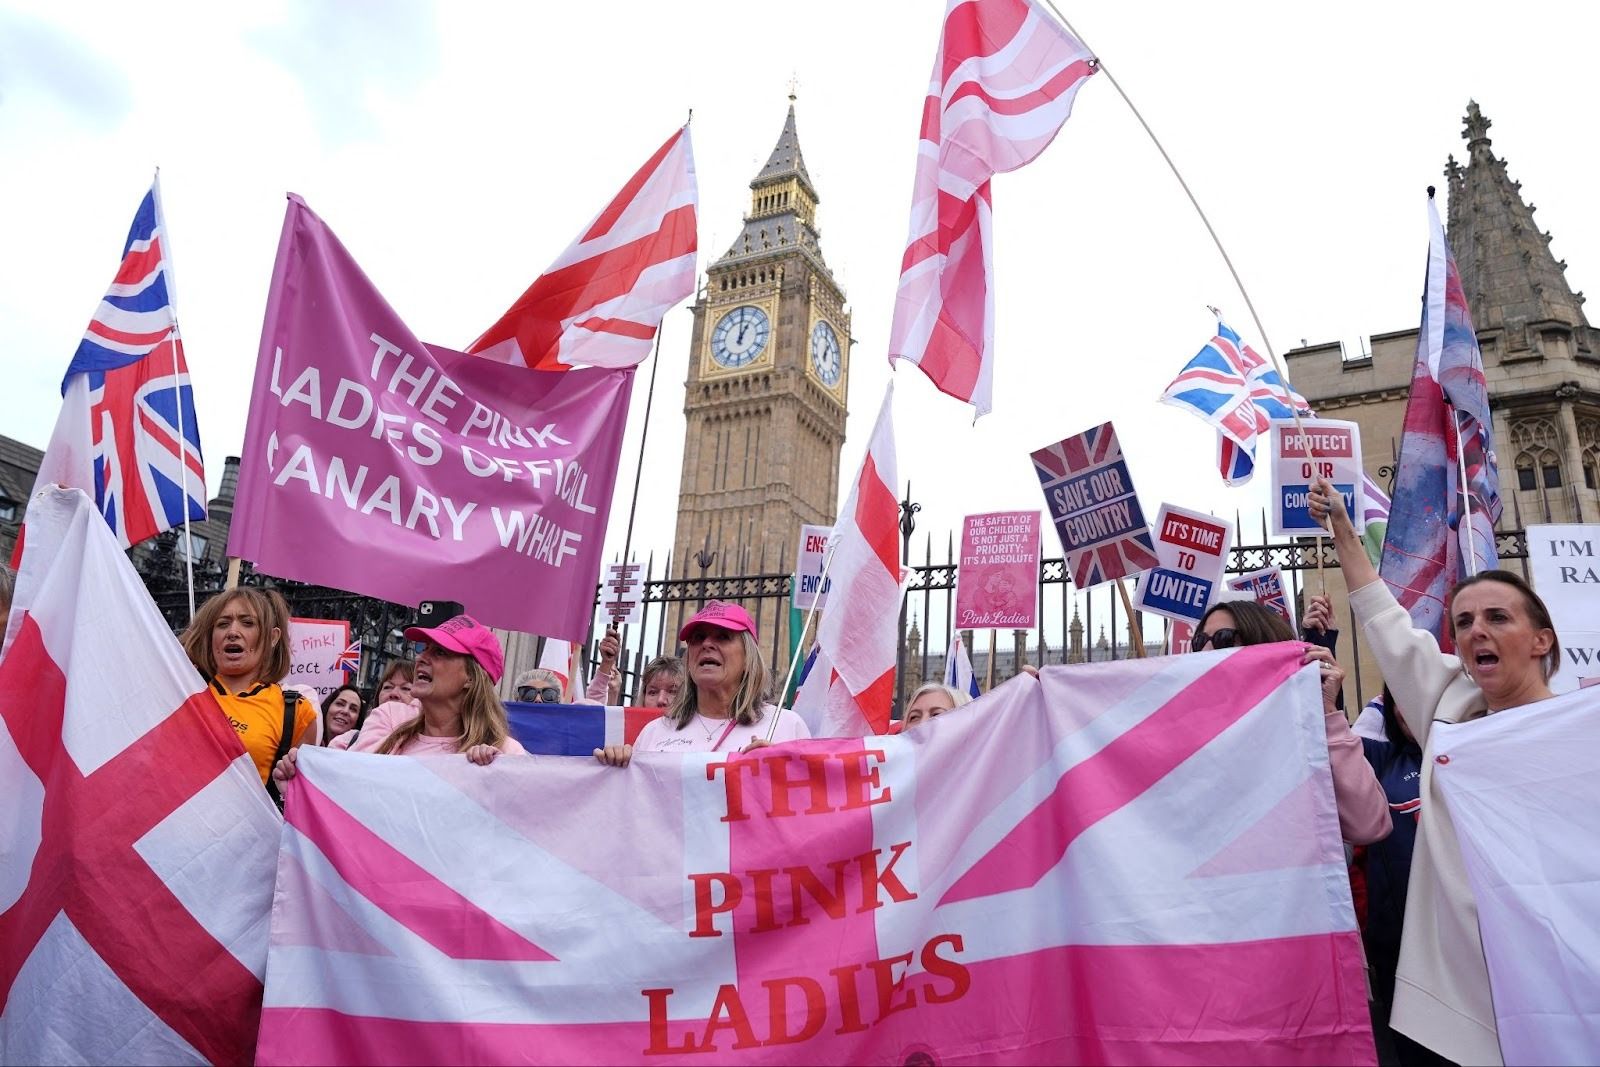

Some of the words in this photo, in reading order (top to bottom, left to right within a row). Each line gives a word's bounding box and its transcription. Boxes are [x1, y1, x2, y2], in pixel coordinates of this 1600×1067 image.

[369, 332, 464, 425] THE
[460, 400, 572, 449] PINK
[1284, 435, 1348, 451] PROTECT
[1301, 462, 1334, 479] OUR
[1053, 479, 1093, 515] SAVE
[1090, 467, 1125, 502] OUR
[969, 519, 984, 528] THE
[986, 516, 1017, 526] SAFETY
[1020, 515, 1032, 524] OF
[969, 527, 986, 536] OUR
[988, 525, 1031, 535] CHILDREN
[1064, 500, 1133, 546] COUNTRY
[490, 507, 583, 567] WHARF
[971, 536, 980, 545] IS
[981, 536, 997, 544] NOT
[999, 534, 1021, 543] JUST
[1022, 534, 1028, 543] A
[1165, 520, 1189, 540] IT'S
[1190, 527, 1221, 549] TIME
[963, 556, 980, 566] IT'S
[980, 556, 987, 565] A
[988, 554, 1034, 564] ABSOLUTE
[1549, 539, 1595, 557] I'M
[1178, 551, 1196, 571] TO
[1150, 573, 1207, 608] UNITE
[960, 609, 991, 625] Pink
[990, 610, 1030, 625] Ladies
[706, 749, 892, 822] THE
[687, 840, 918, 938] PINK
[641, 934, 972, 1056] LADIES
